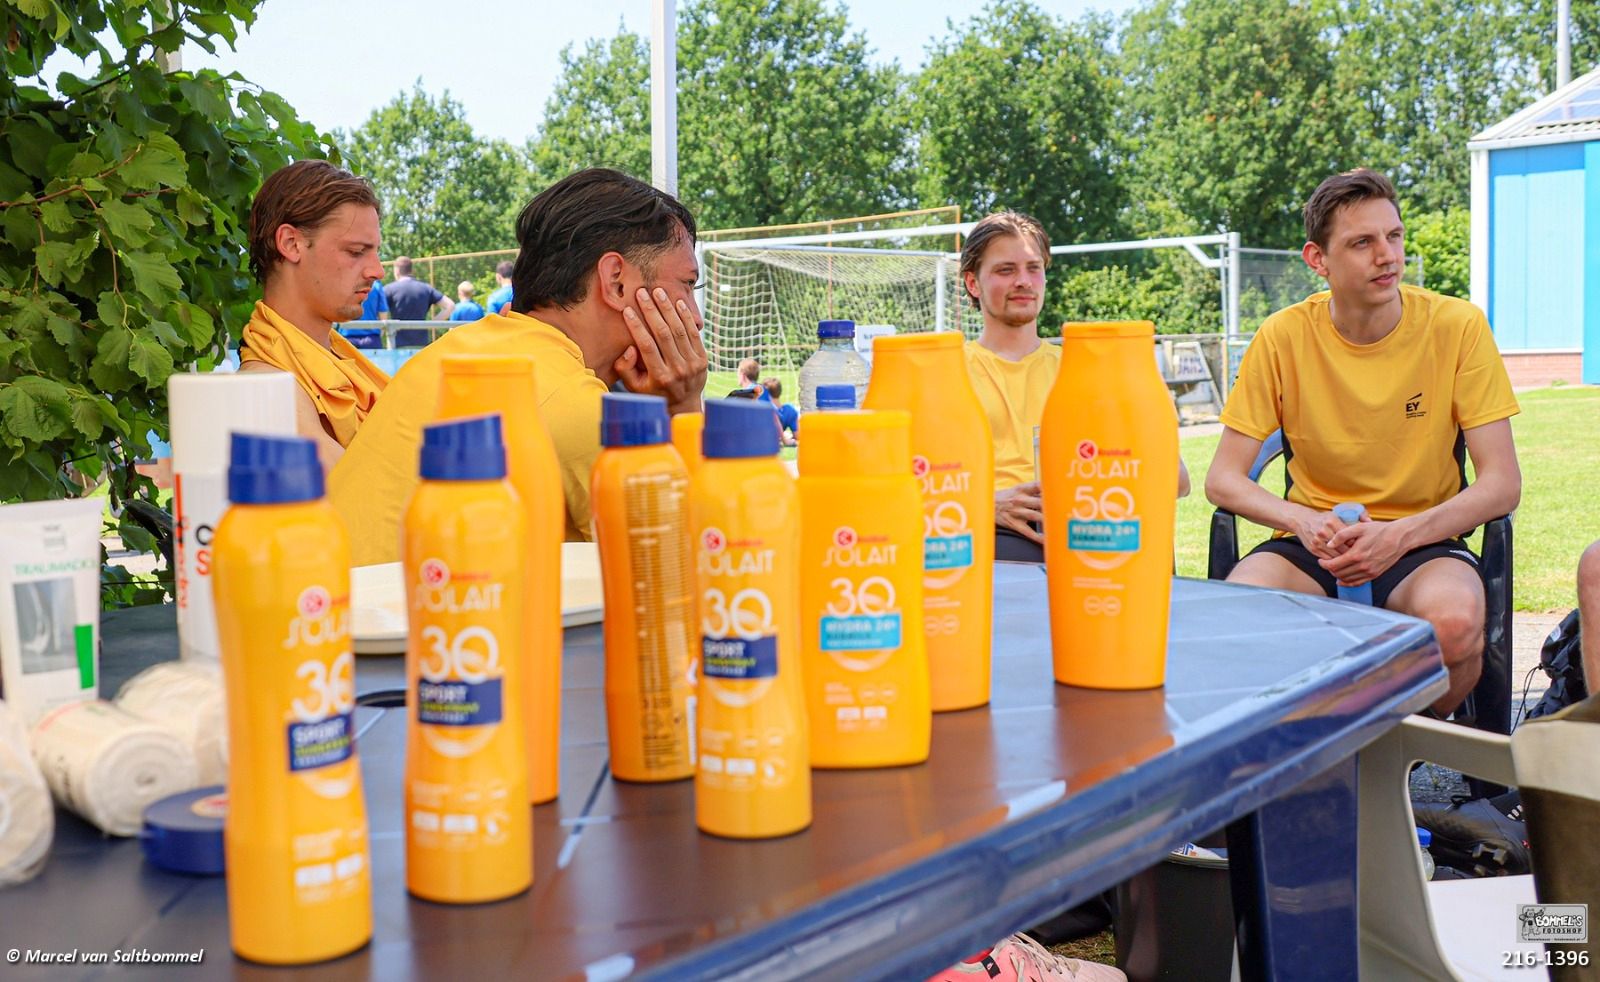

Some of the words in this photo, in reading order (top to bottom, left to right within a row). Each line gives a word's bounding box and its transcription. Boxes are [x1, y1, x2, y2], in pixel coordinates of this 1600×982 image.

[1406, 401, 1420, 412] EY
[1066, 459, 1142, 479] SOLAIT
[821, 544, 898, 568] SOLAIT
[826, 576, 896, 618] 30
[703, 587, 773, 641] 30
[420, 625, 500, 684] 30
